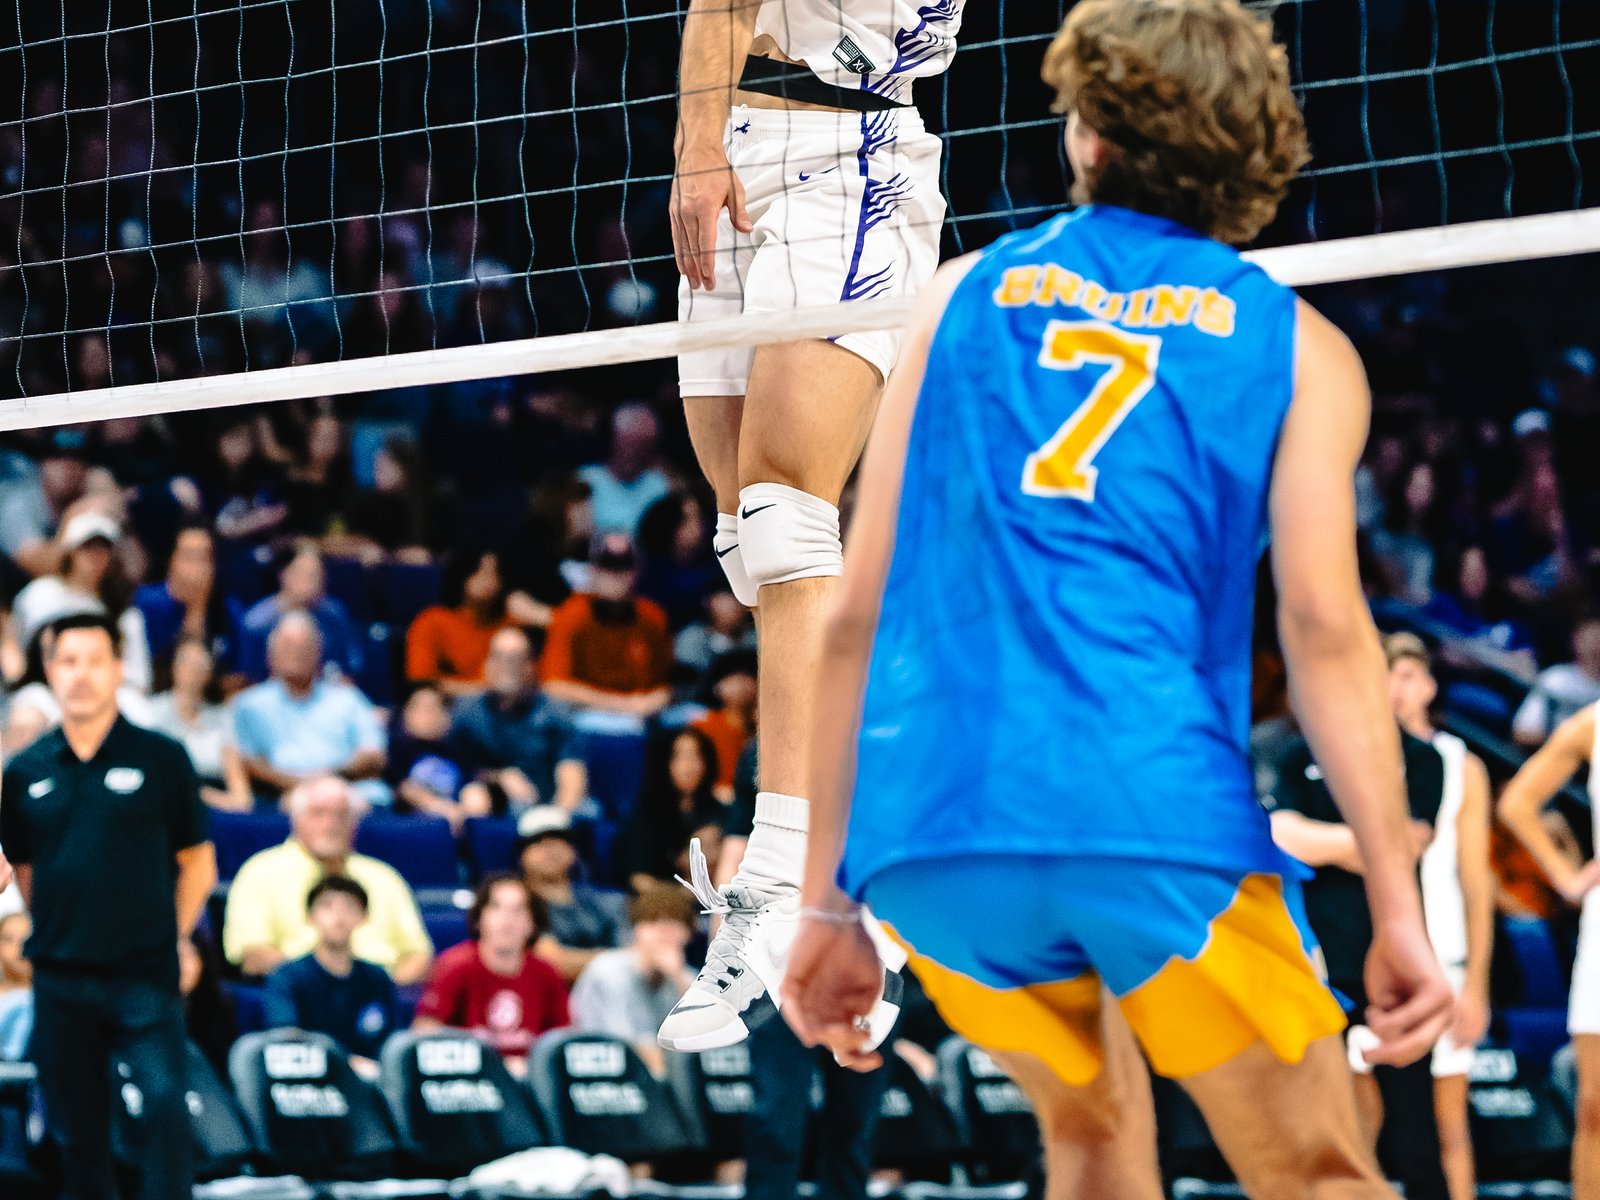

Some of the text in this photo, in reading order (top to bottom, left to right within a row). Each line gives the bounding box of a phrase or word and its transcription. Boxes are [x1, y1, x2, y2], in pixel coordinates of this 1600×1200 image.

[853, 60, 865, 73] XL
[993, 262, 1236, 338] BRUINS
[1021, 319, 1162, 504] 7
